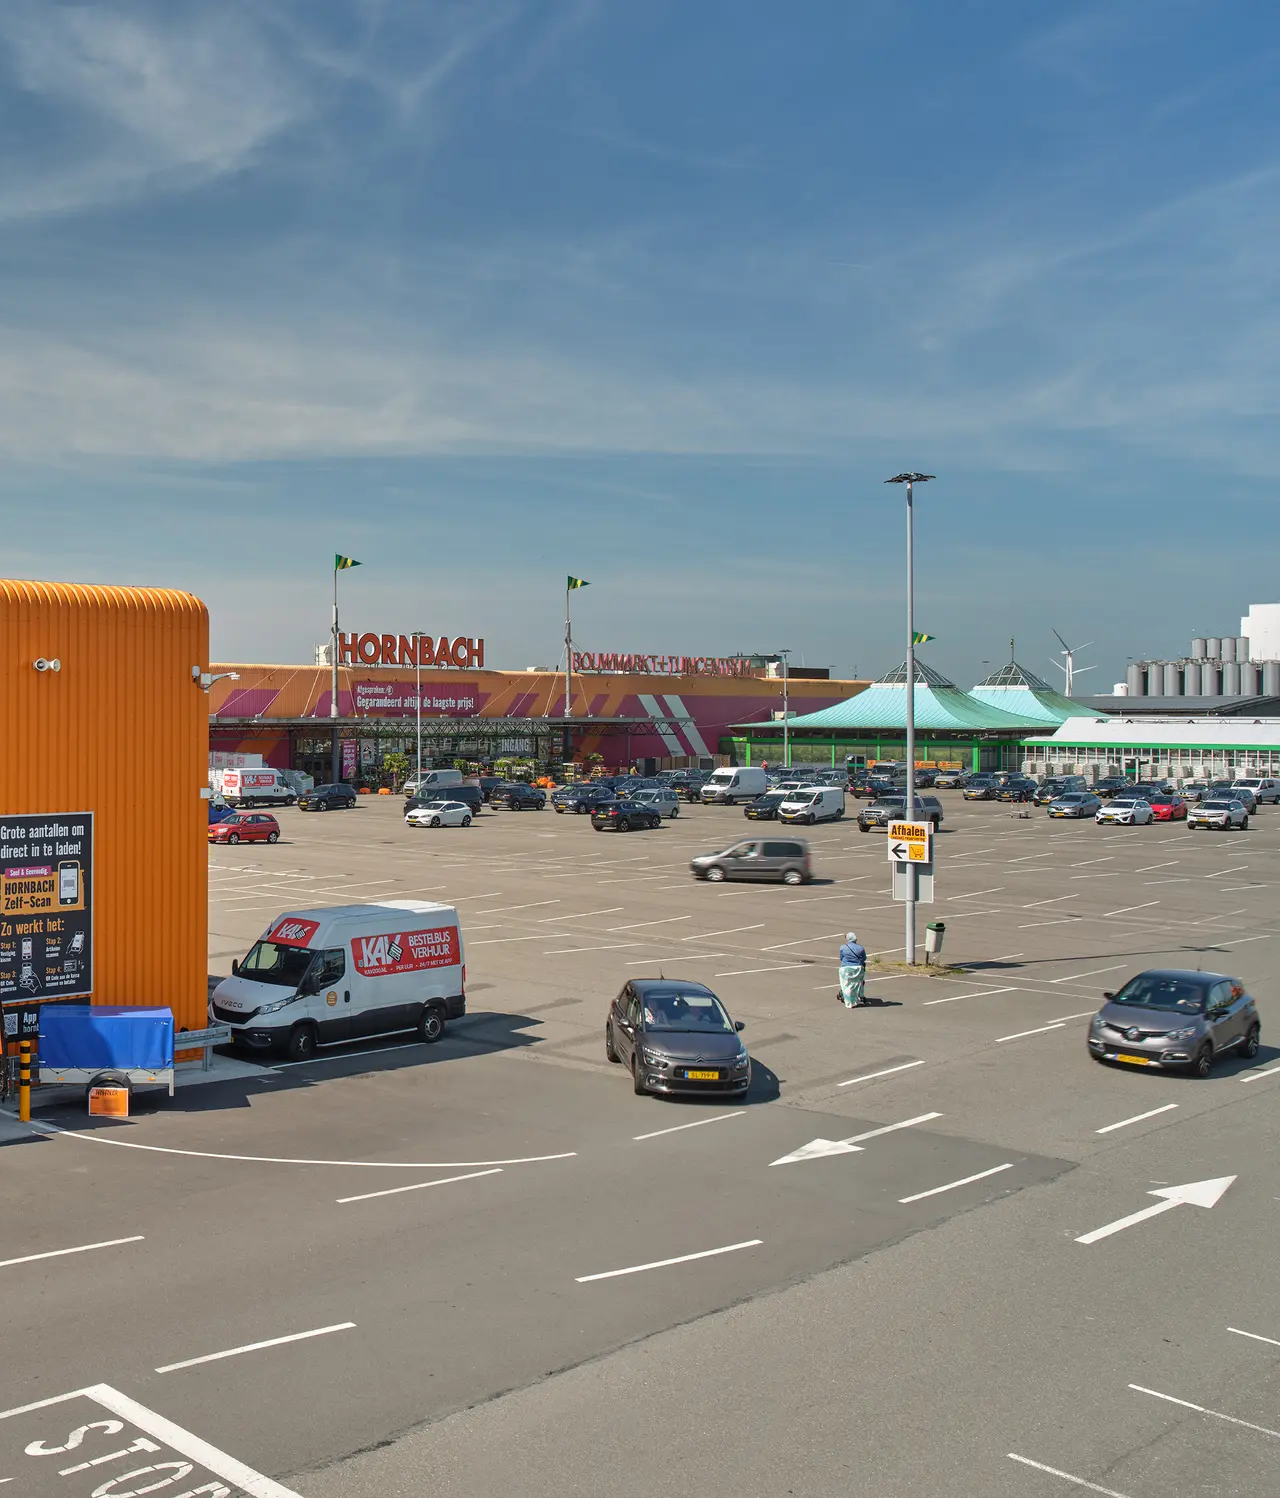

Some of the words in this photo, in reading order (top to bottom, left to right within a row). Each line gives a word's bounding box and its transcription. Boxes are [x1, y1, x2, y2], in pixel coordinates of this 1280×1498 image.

[338, 633, 485, 667] HORNBACH
[357, 696, 402, 709] Gegarandeerd
[423, 697, 431, 707] de
[432, 697, 455, 710] laagste
[501, 738, 529, 752] INGANG
[0, 825, 26, 840] Grote
[28, 823, 69, 839] aantallen
[71, 825, 85, 836] om
[891, 825, 925, 836] Afhalen
[0, 844, 28, 859] direct
[31, 843, 40, 857] in
[43, 843, 53, 856] te
[55, 841, 81, 856] laden!
[4, 880, 55, 895] HORNBACH
[5, 896, 51, 910] Zelf-Scan
[0, 922, 12, 936] Zo
[16, 919, 43, 935] werkt
[47, 918, 65, 932] het:
[0, 942, 11, 950] Stap
[45, 937, 56, 945] Stap
[408, 931, 451, 947] BESTELBUS
[411, 944, 451, 959] VERHUUR
[23, 1012, 37, 1024] App
